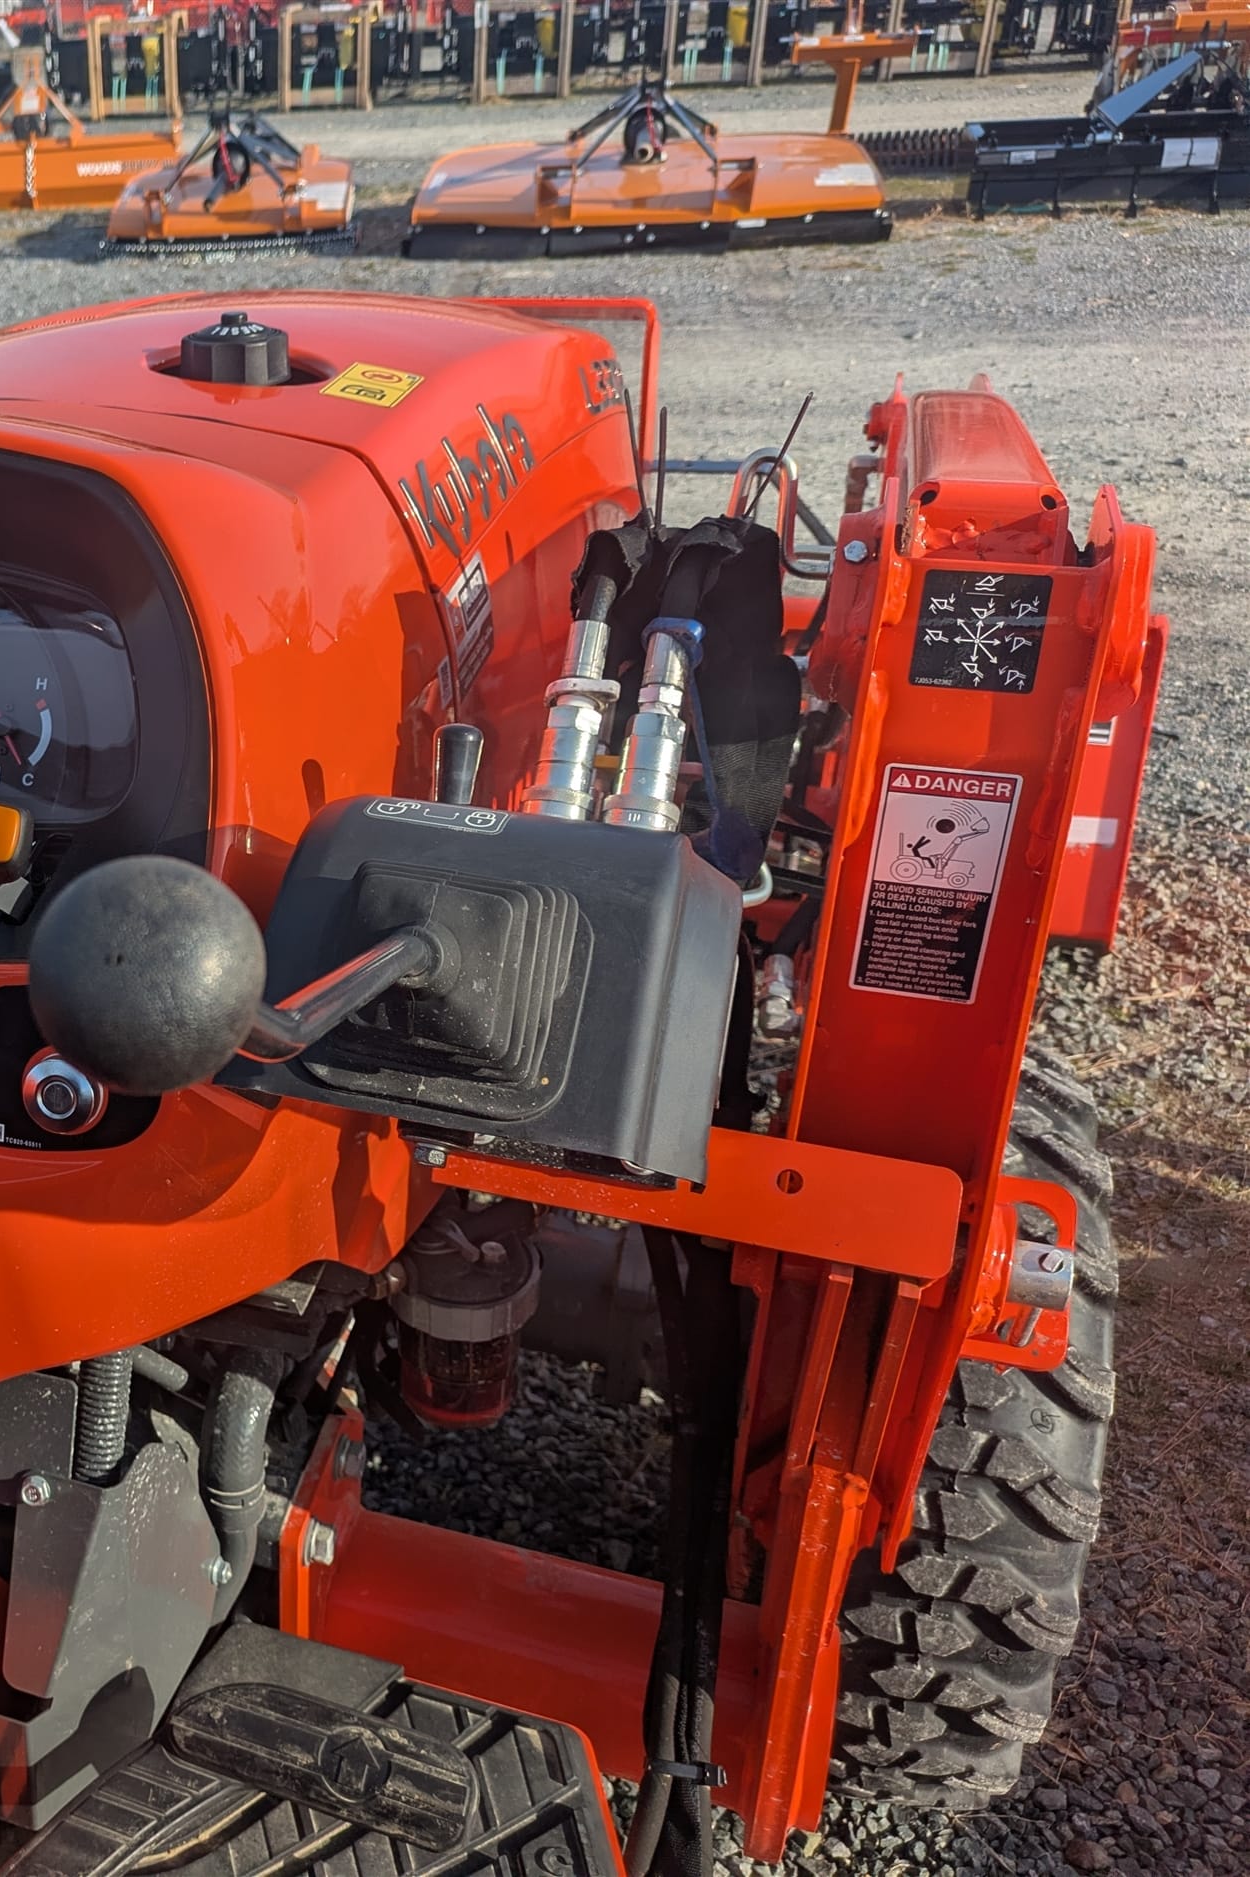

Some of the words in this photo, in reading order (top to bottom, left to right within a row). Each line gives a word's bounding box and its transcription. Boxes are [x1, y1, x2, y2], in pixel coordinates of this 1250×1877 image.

[398, 402, 535, 558] Kubota
[35, 677, 48, 691] H
[22, 772, 35, 787] C
[915, 774, 1012, 798] DANGER
[872, 891, 886, 899] OR
[887, 892, 916, 903] DEATH
[917, 896, 955, 908] CAUSED
[956, 901, 968, 909] BY
[873, 882, 886, 891] TO
[887, 883, 914, 894] AVOID
[915, 887, 954, 899] SERIOUS
[956, 892, 989, 903] INJURY
[870, 900, 907, 911] FALLING
[908, 904, 942, 915] LOADS:
[876, 911, 894, 919] Load
[906, 914, 927, 922] raised
[928, 916, 952, 925] bucket
[962, 920, 977, 928] fork
[889, 919, 900, 927] fall
[910, 921, 922, 929] roll
[923, 923, 940, 931] back
[941, 926, 958, 934] onto
[874, 927, 903, 936] operator
[904, 930, 931, 940] causing
